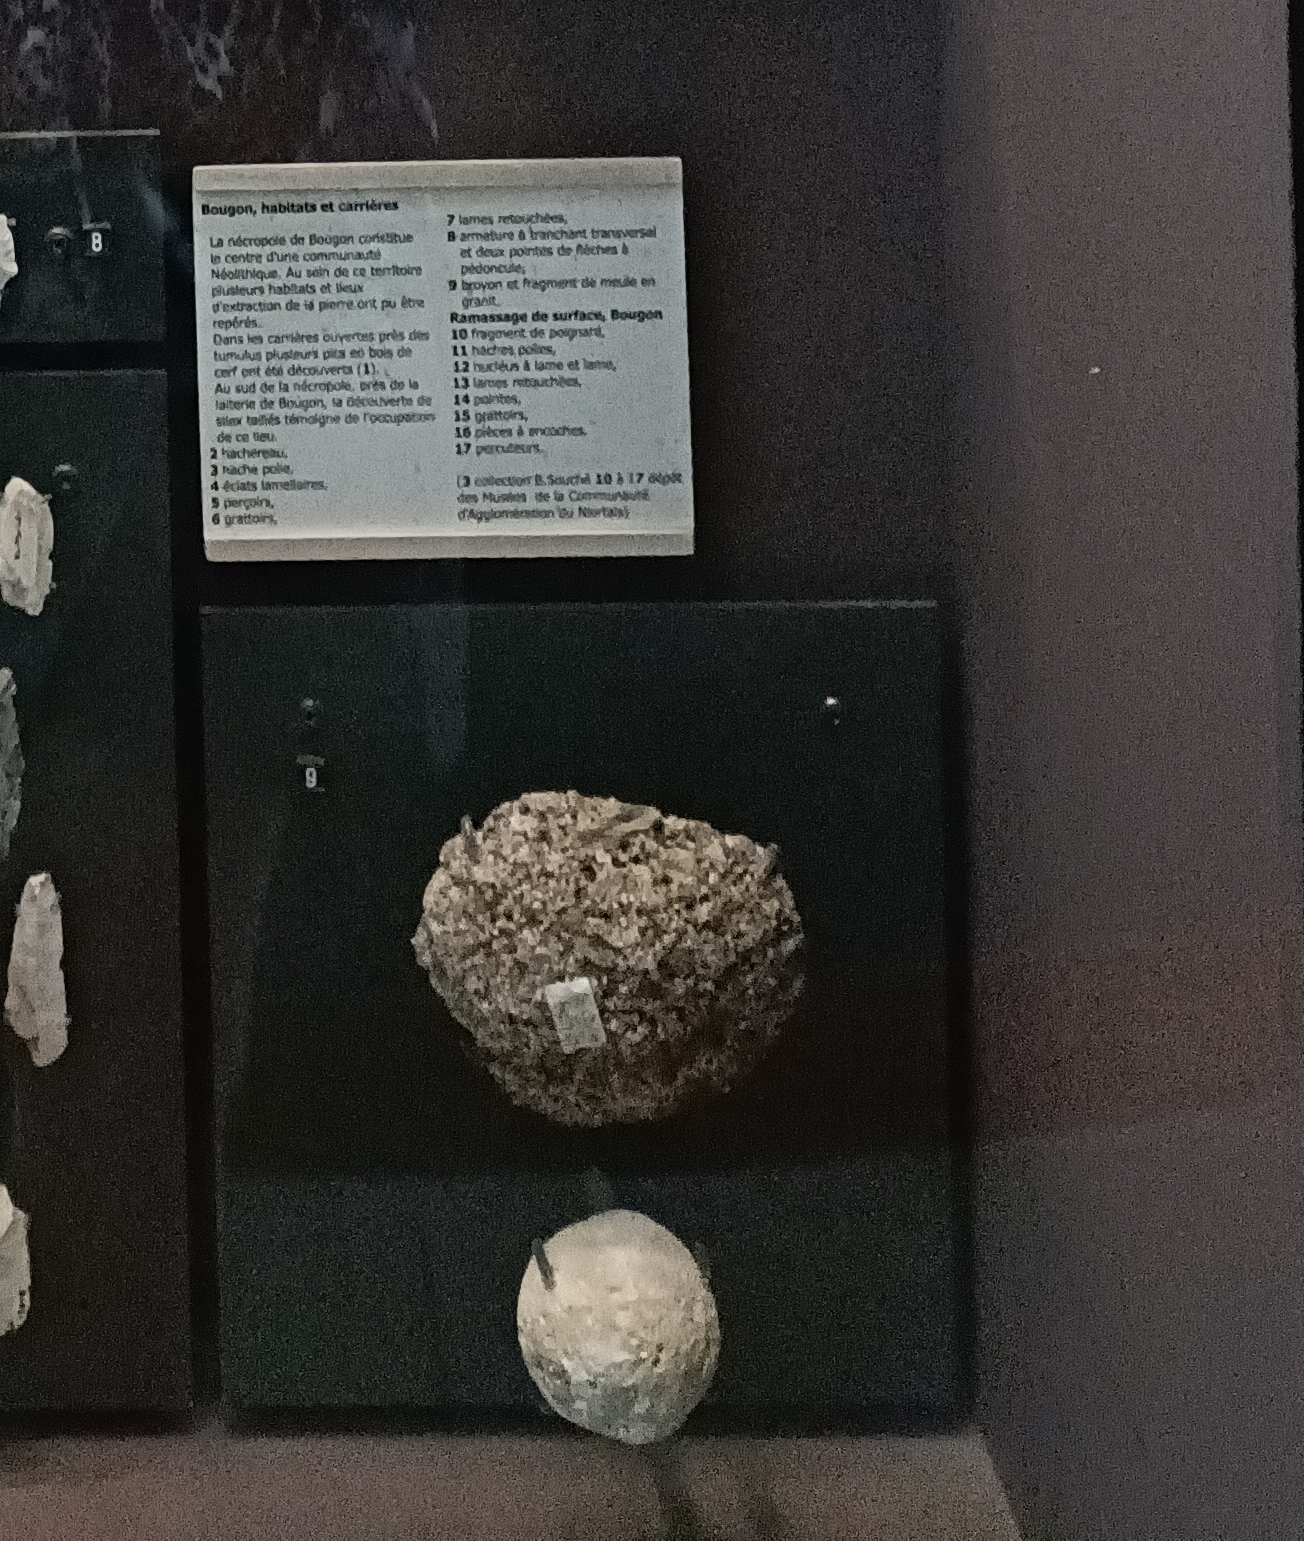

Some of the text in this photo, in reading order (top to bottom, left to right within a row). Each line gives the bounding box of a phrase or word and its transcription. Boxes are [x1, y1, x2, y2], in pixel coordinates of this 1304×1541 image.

[202, 201, 399, 216] Bougon, habitats et carrières
[447, 214, 455, 226] 7
[459, 214, 493, 225] lames
[210, 237, 223, 248] La
[291, 235, 304, 245] de
[309, 234, 354, 247] Bougon
[359, 233, 414, 244] constitue
[448, 232, 456, 242] 8
[460, 230, 514, 241] armature
[518, 228, 526, 240] à
[530, 227, 587, 240] tranchant
[461, 248, 472, 258] et
[476, 246, 504, 257] deux
[509, 246, 553, 258] pointes
[557, 246, 572, 256] de
[622, 242, 628, 254] à
[211, 250, 381, 264] le centre d'une communauté
[286, 268, 302, 278] Au
[307, 268, 329, 277] sein
[334, 267, 348, 277] de
[353, 268, 366, 277] ce
[371, 266, 422, 276] territoire
[449, 280, 457, 290] 9
[507, 279, 518, 289] et
[582, 278, 596, 288] de
[601, 277, 637, 287] meule
[641, 278, 655, 287] en
[212, 283, 364, 297] plusieurs habitats et lieux
[213, 296, 424, 313] d'extraction de la pierre ont pu être
[450, 309, 663, 325] Ramassage de surface, Bougon
[213, 330, 430, 345] Dans les carrières ouvertes près des
[452, 329, 467, 340] 10
[530, 327, 544, 337] de
[214, 346, 412, 361] tumulus plusieurs en bois de
[453, 346, 468, 356] 11
[215, 367, 237, 378] cerf
[242, 367, 261, 377] ont
[265, 365, 283, 375] été
[454, 360, 580, 372] 12 à lame et
[215, 384, 230, 394] Au
[235, 382, 255, 393] sud
[260, 382, 275, 392] de
[279, 381, 289, 392] la
[390, 380, 404, 390] de
[409, 379, 419, 389] la
[454, 378, 469, 388] 13
[260, 399, 274, 409] de
[279, 398, 327, 410] Bougon,
[332, 398, 342, 408] la
[417, 396, 432, 406] de
[454, 395, 469, 405] 14
[285, 412, 340, 427] témoigne
[345, 412, 359, 423] de
[455, 411, 470, 422] 15
[217, 432, 231, 443] de
[236, 433, 249, 442] ce
[455, 428, 470, 438] 16
[517, 426, 523, 437] à
[210, 448, 217, 459] 2
[456, 444, 471, 454] 17
[210, 465, 218, 476] 3
[222, 464, 258, 475] hache
[596, 474, 611, 485] 10
[628, 473, 643, 484] 17
[211, 482, 218, 491] 4
[458, 492, 478, 503] des
[535, 492, 550, 502] de
[554, 491, 564, 502] la
[211, 498, 219, 509] 5
[212, 514, 220, 525] 6
